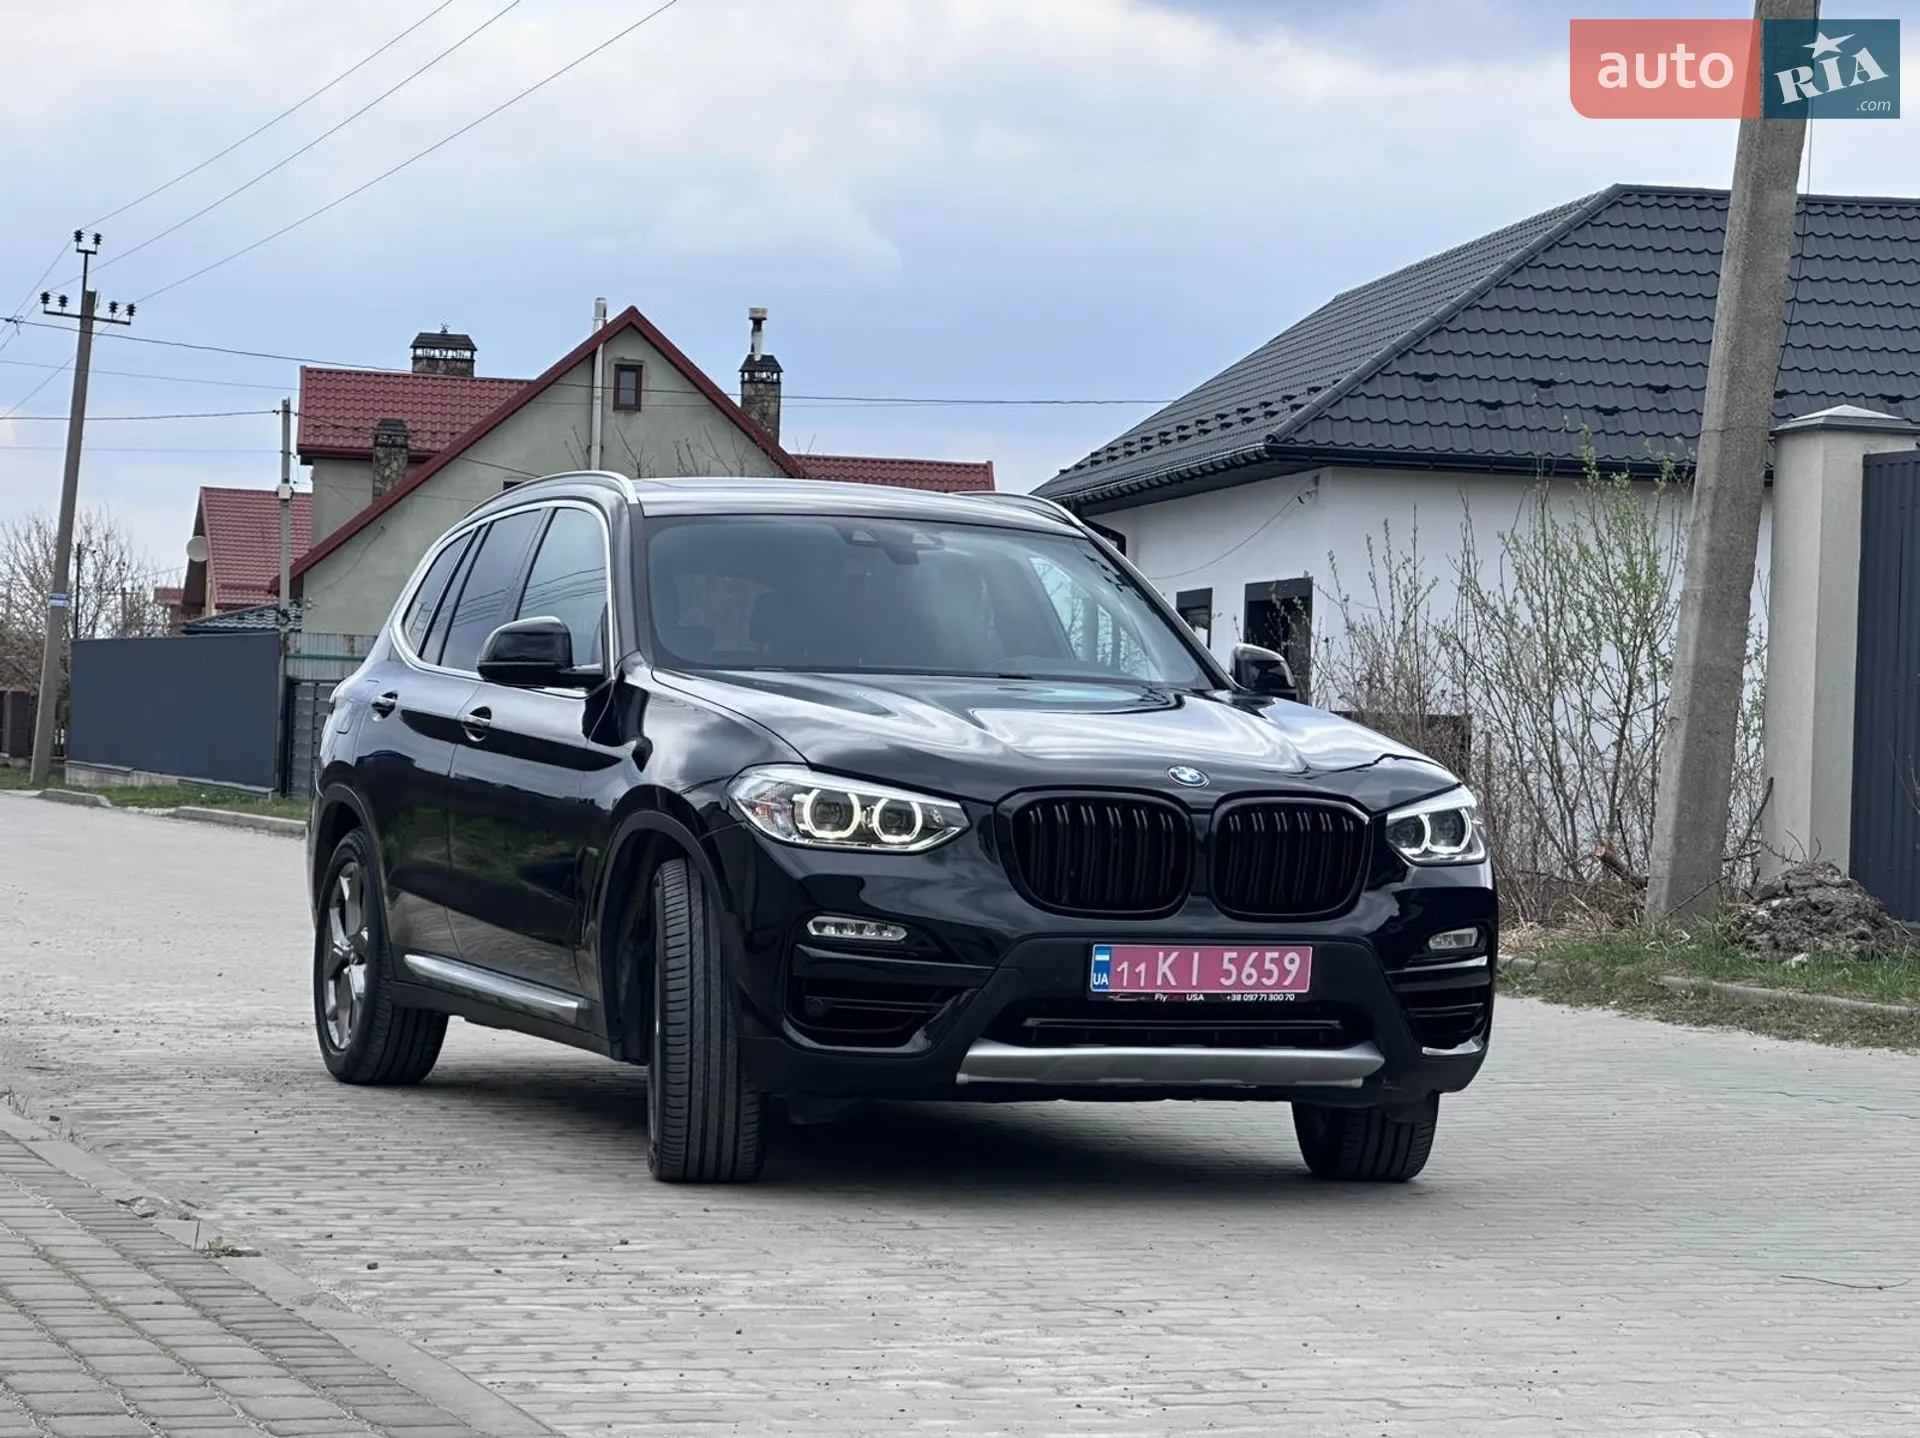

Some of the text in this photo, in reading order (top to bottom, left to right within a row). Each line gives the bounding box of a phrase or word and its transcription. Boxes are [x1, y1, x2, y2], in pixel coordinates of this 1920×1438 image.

[1093, 973, 1109, 986] UA
[1219, 951, 1301, 987] 5659
[1186, 993, 1205, 1002] USA
